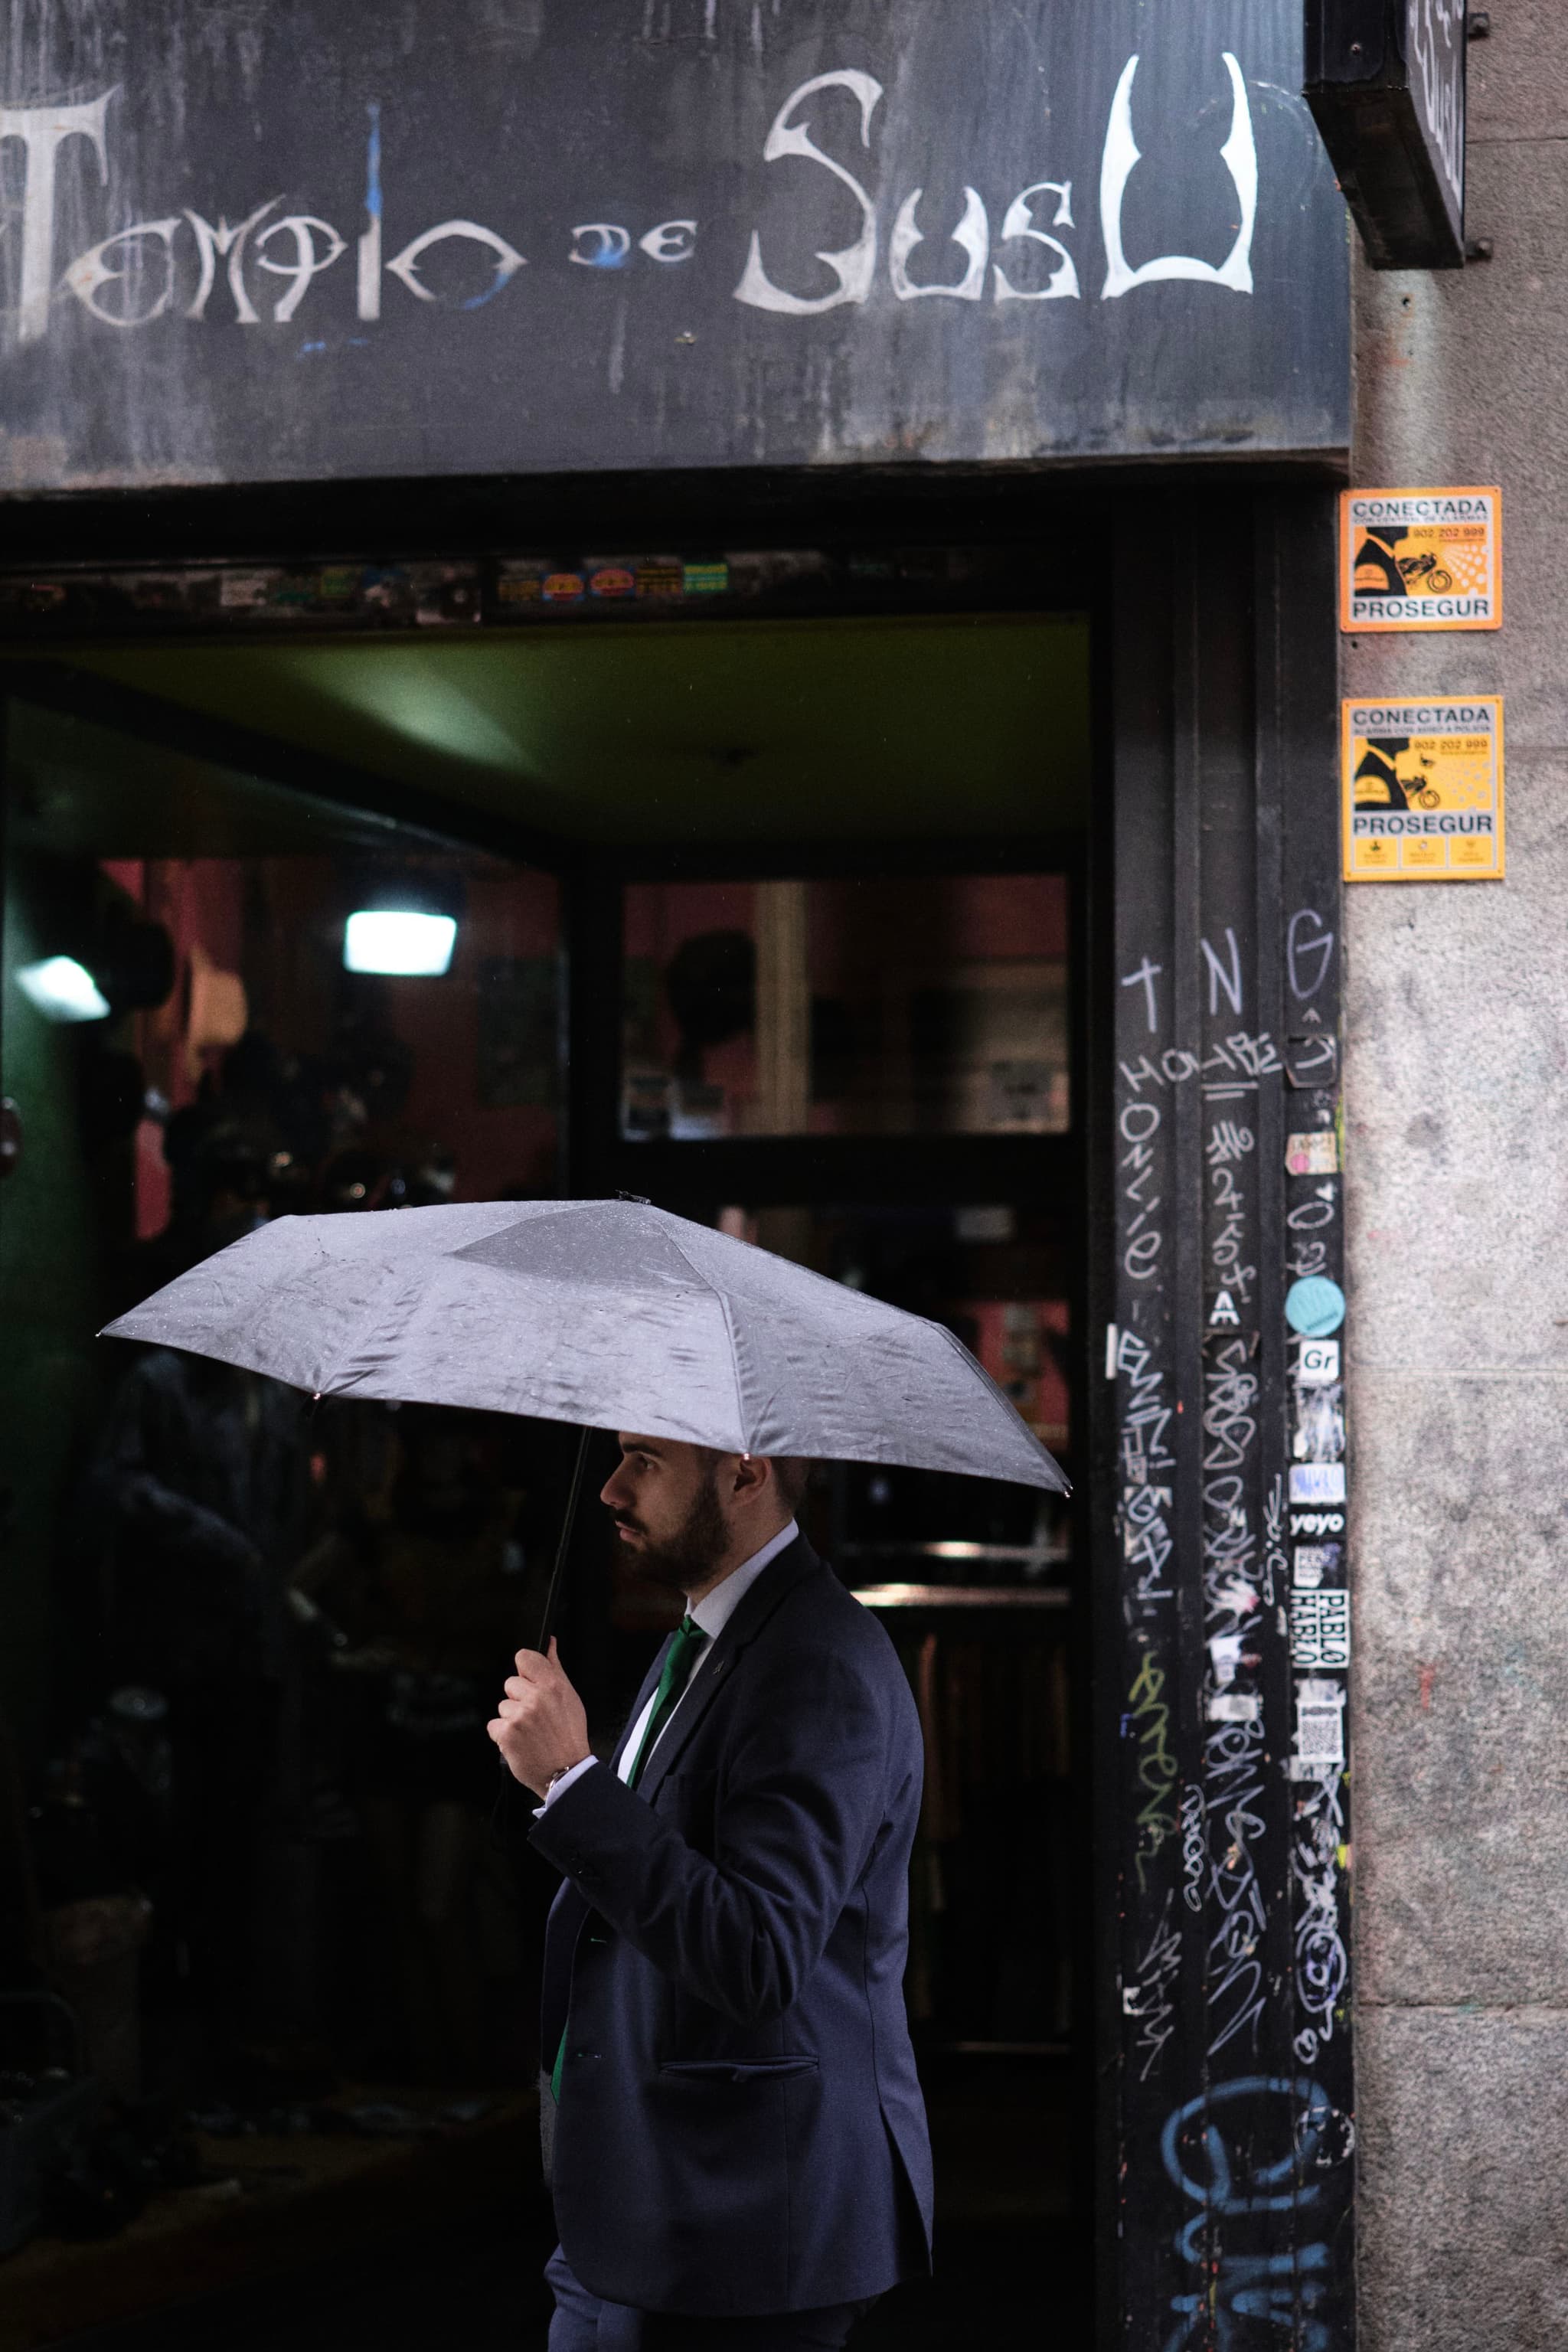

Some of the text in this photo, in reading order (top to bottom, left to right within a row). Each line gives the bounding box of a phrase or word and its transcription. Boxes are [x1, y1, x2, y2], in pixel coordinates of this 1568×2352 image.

[1353, 500, 1488, 517] CONECTADA
[1353, 599, 1489, 618] PROSEGUR
[1354, 707, 1490, 725] CONECTADA
[1354, 815, 1492, 835] PROSEGUR
[1304, 1349, 1335, 1370] Gr
[1289, 1512, 1344, 1537] yeyo
